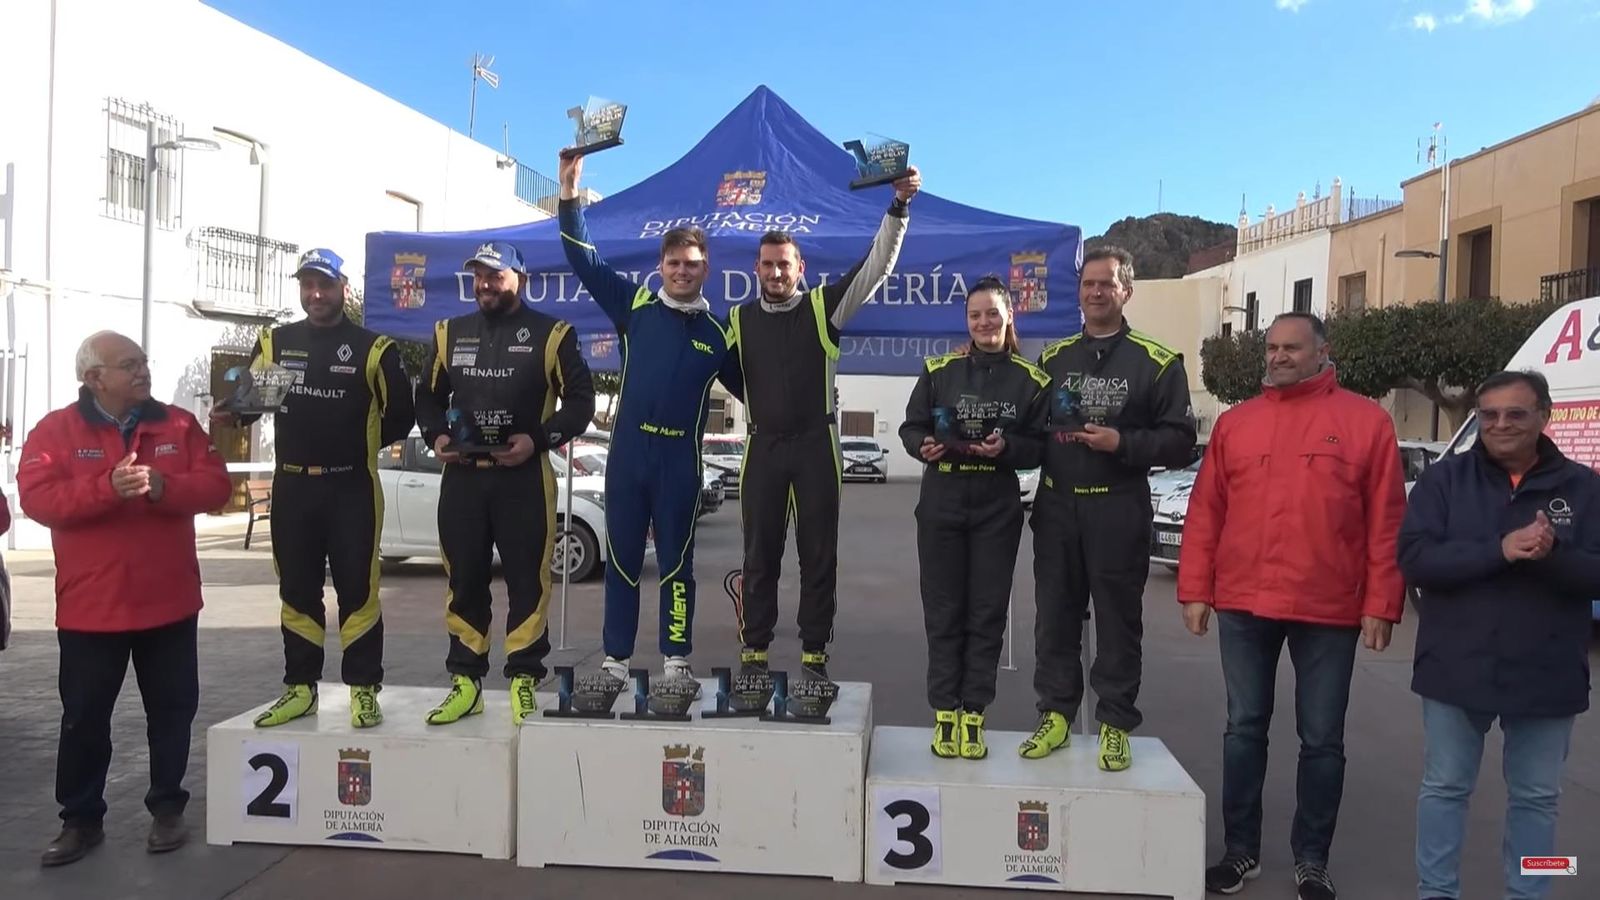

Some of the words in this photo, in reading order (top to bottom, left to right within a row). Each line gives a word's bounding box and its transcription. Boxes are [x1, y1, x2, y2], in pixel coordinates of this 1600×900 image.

[644, 211, 821, 231] DIPUTACIÓN
[462, 367, 515, 378] RENAULT
[290, 385, 346, 399] RENAULT
[808, 689, 834, 697] FELIX
[247, 753, 290, 818] 2
[324, 809, 385, 821] DIPUTACIÓN
[326, 820, 338, 830] DE
[340, 820, 383, 832] ALMERÍA
[643, 819, 721, 834] DIPUTACIÓN
[645, 833, 661, 844] DE
[664, 833, 719, 847] ALMERÍA
[883, 799, 933, 870] 3
[1004, 854, 1061, 864] DIPUTACIÓN
[1006, 863, 1018, 872] DE
[1020, 863, 1060, 873] ALMERÍA
